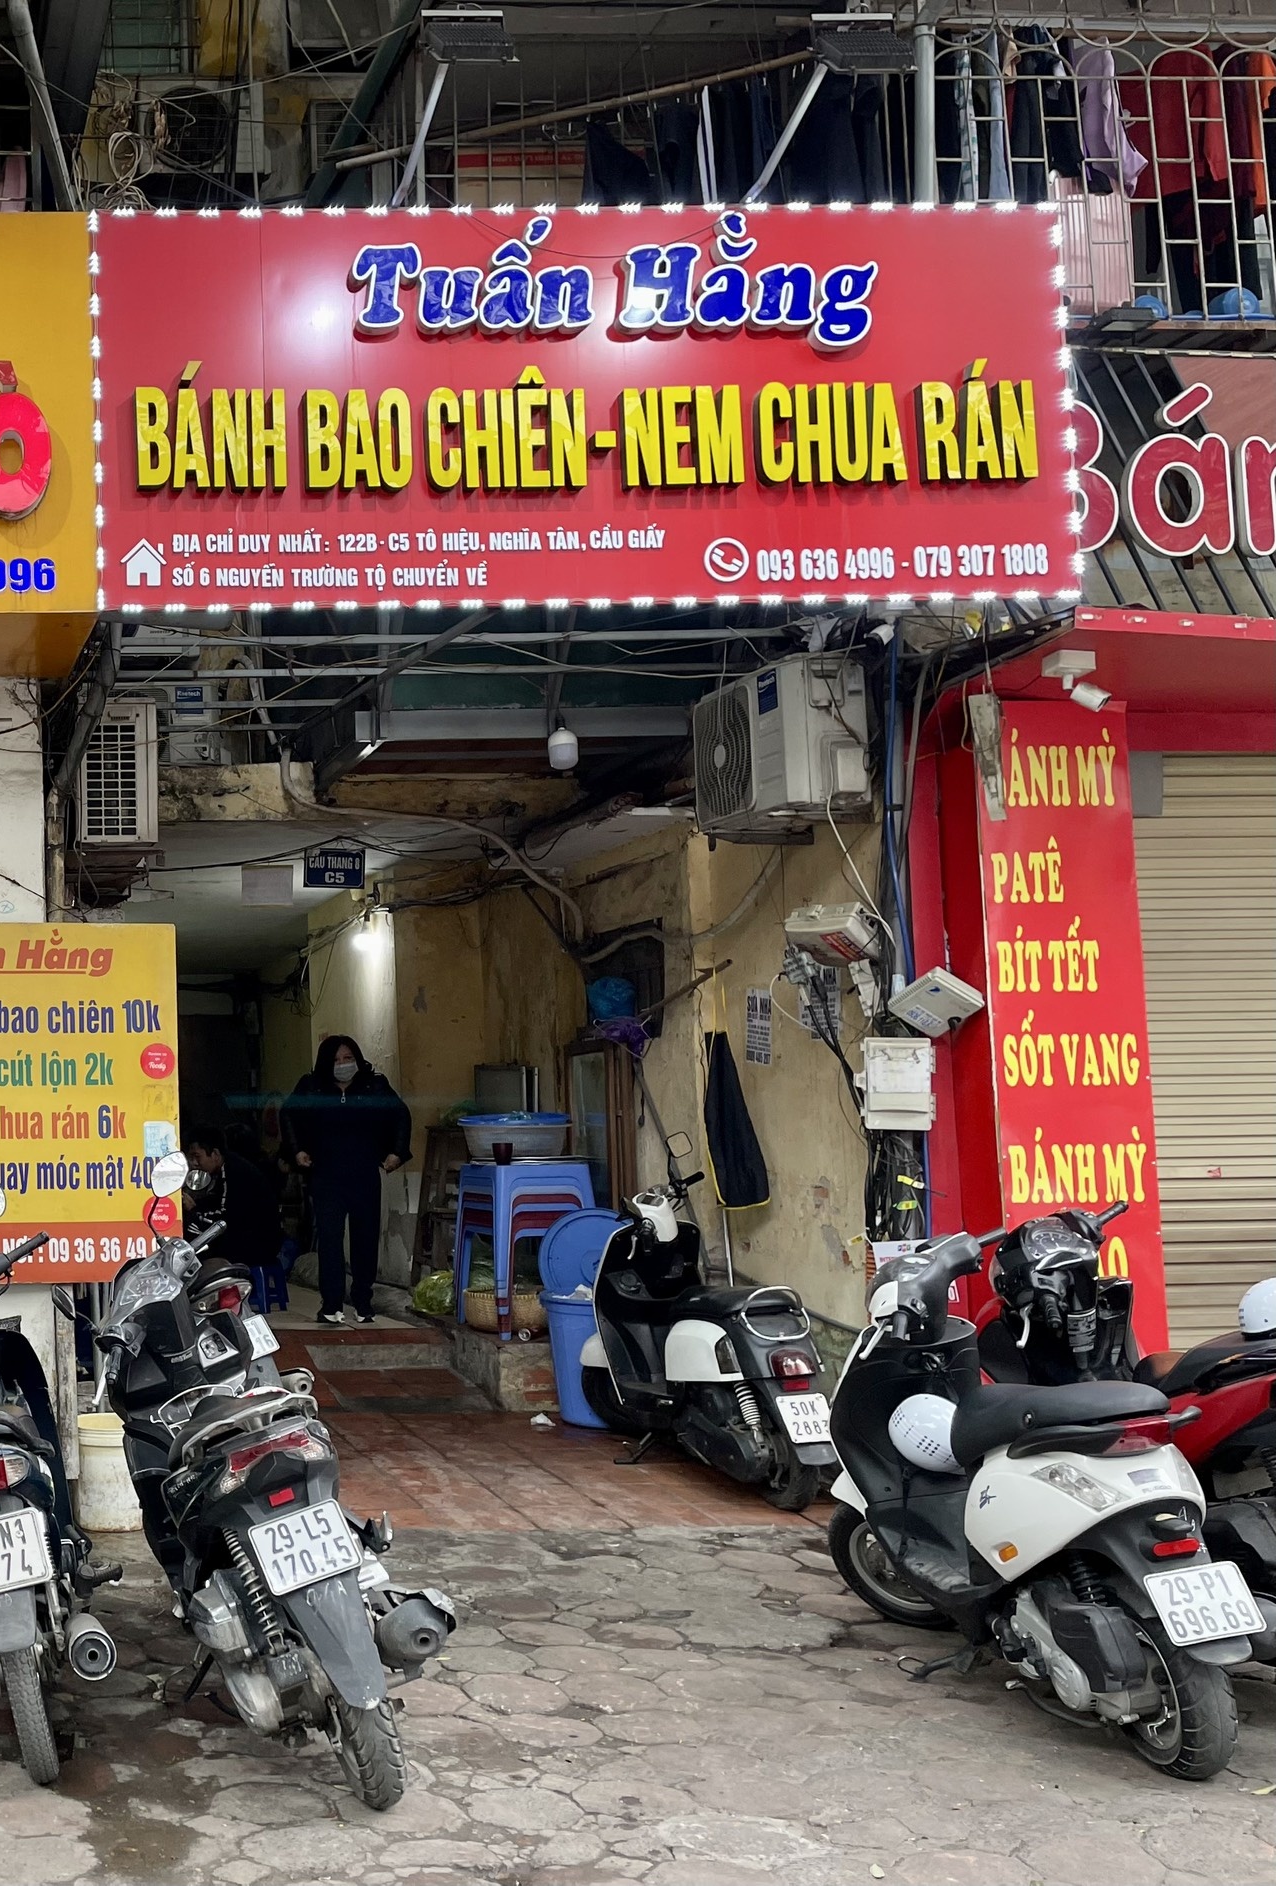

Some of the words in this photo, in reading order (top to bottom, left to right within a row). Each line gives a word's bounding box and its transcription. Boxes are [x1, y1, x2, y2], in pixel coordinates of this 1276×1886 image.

[350, 216, 594, 333] Tuấn
[617, 211, 878, 350] Hằng
[133, 361, 287, 491] BÁNH
[302, 387, 414, 491] BAO
[756, 380, 909, 487] CHUA
[920, 357, 1039, 486] RÁN
[172, 532, 201, 556] ĐỊA
[205, 528, 234, 553] CHỈ
[238, 532, 271, 553] DUY
[416, 530, 437, 552] TÔ
[442, 528, 486, 556] HIỆU,
[489, 527, 540, 553] NGHĨA
[546, 528, 585, 554] TÂN,
[589, 523, 623, 549] CẦU
[627, 522, 666, 549] GIẤY
[172, 561, 195, 587] SỐ
[199, 567, 211, 587] 6
[216, 562, 284, 587] NGUYỄN
[291, 563, 358, 587] TRƯỜNG
[365, 563, 386, 591] TỘ
[392, 559, 459, 587] CHUYỂN
[466, 560, 488, 587] VỀ
[756, 547, 796, 582] 093
[800, 546, 841, 581] 636
[845, 546, 895, 580] 4996
[913, 545, 955, 579] 079
[959, 544, 995, 578] 307
[1003, 542, 1049, 577] 1808
[1003, 728, 1072, 807] ÁNH
[325, 872, 345, 883] C5
[327, 857, 353, 869] THANG
[355, 857, 360, 869] 8
[990, 835, 1065, 903] PATÊ
[16, 929, 114, 977] Hằng
[996, 926, 1041, 992] BÍT
[1048, 916, 1100, 992] TẾT
[48, 1000, 114, 1034] chiên
[122, 999, 161, 1033] 10k
[1003, 1010, 1054, 1087] SỐT
[1060, 1033, 1140, 1087] VANG
[41, 1051, 76, 1093] lộn
[85, 1052, 114, 1086] 2k
[51, 1104, 89, 1139] rán
[98, 1104, 126, 1139] 6k
[37, 1155, 80, 1189] móc
[86, 1155, 124, 1196] mật
[130, 1156, 161, 1189] 40
[1008, 1127, 1098, 1204] BÁNH
[1103, 1126, 1147, 1203] MỲ
[49, 1237, 69, 1263] 09
[74, 1237, 95, 1263] 36
[100, 1237, 120, 1263] 36
[126, 1237, 146, 1259] 49
[790, 1401, 819, 1416] 50K
[264, 1508, 332, 1555] 29-L5
[272, 1536, 352, 1586] 170.45
[1161, 1570, 1233, 1606] 29-P1
[1168, 1600, 1255, 1638] 696.69
